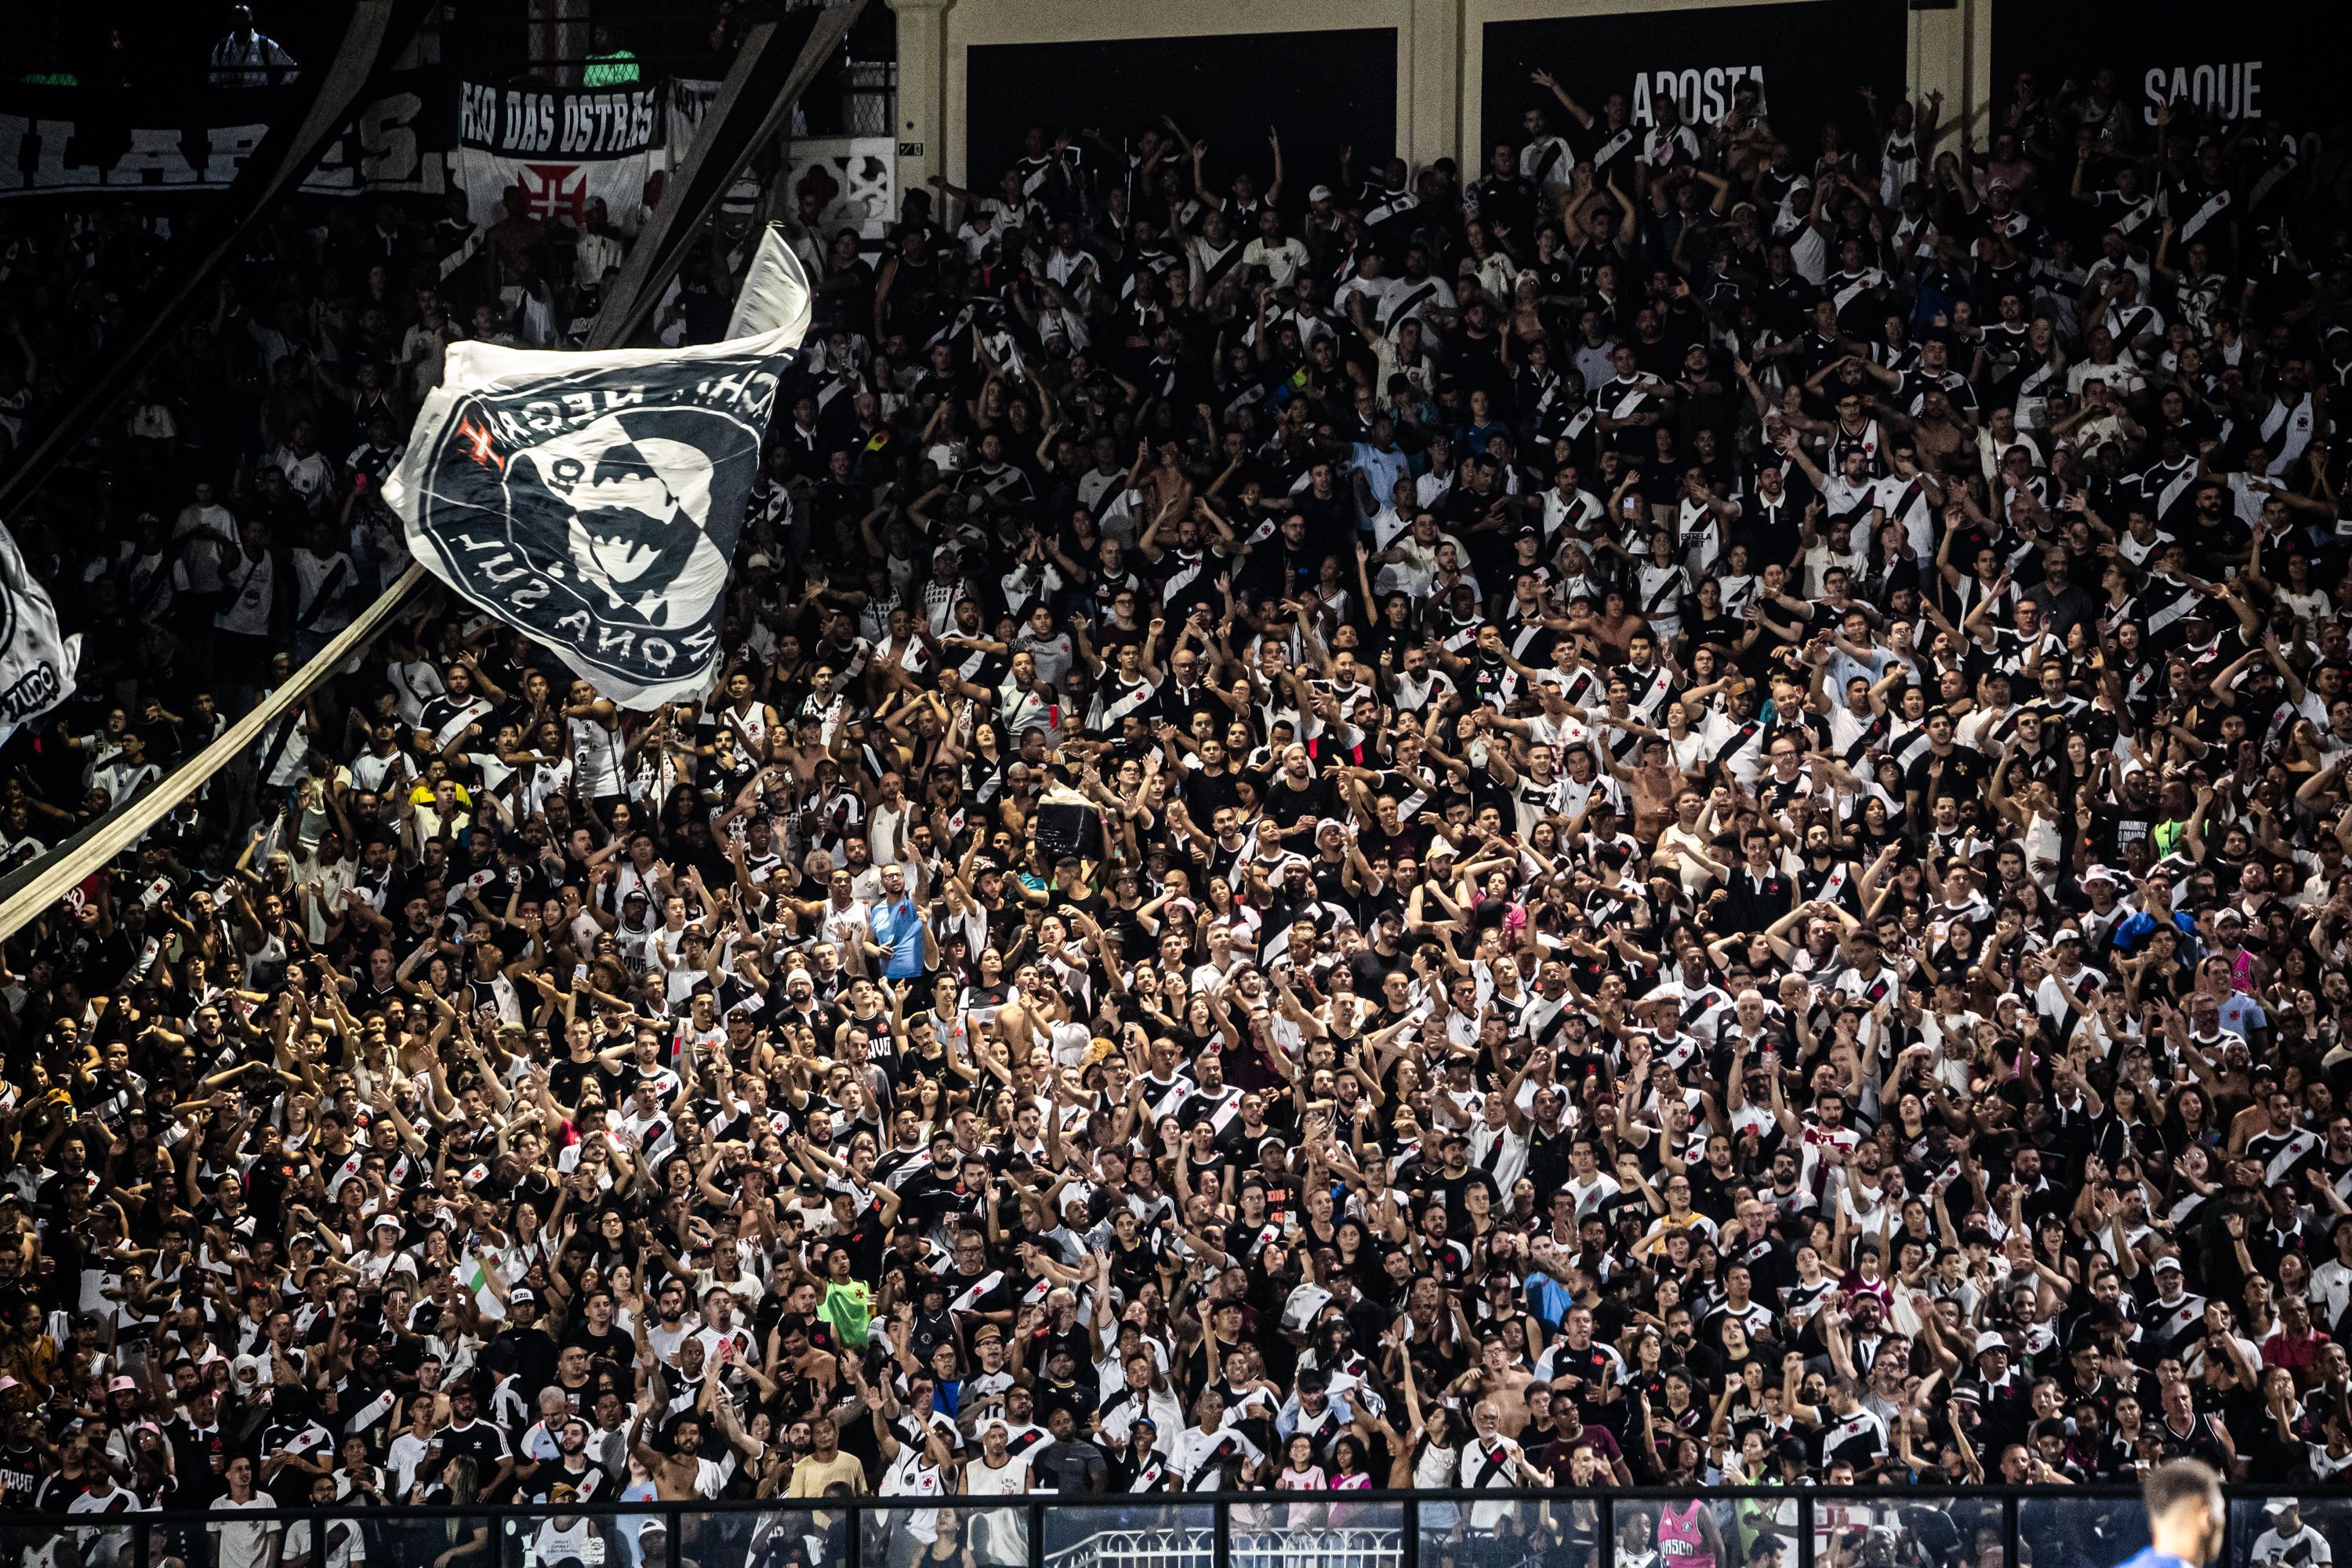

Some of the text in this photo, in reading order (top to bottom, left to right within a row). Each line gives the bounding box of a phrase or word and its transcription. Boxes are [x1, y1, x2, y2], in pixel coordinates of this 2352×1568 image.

[461, 82, 496, 147] RIO
[503, 92, 554, 151] DAS
[559, 86, 656, 153] OSTRAS
[2143, 60, 2263, 126] SAQUE
[6, 665, 55, 715] TUDO
[2118, 820, 2148, 831] DINAMITE
